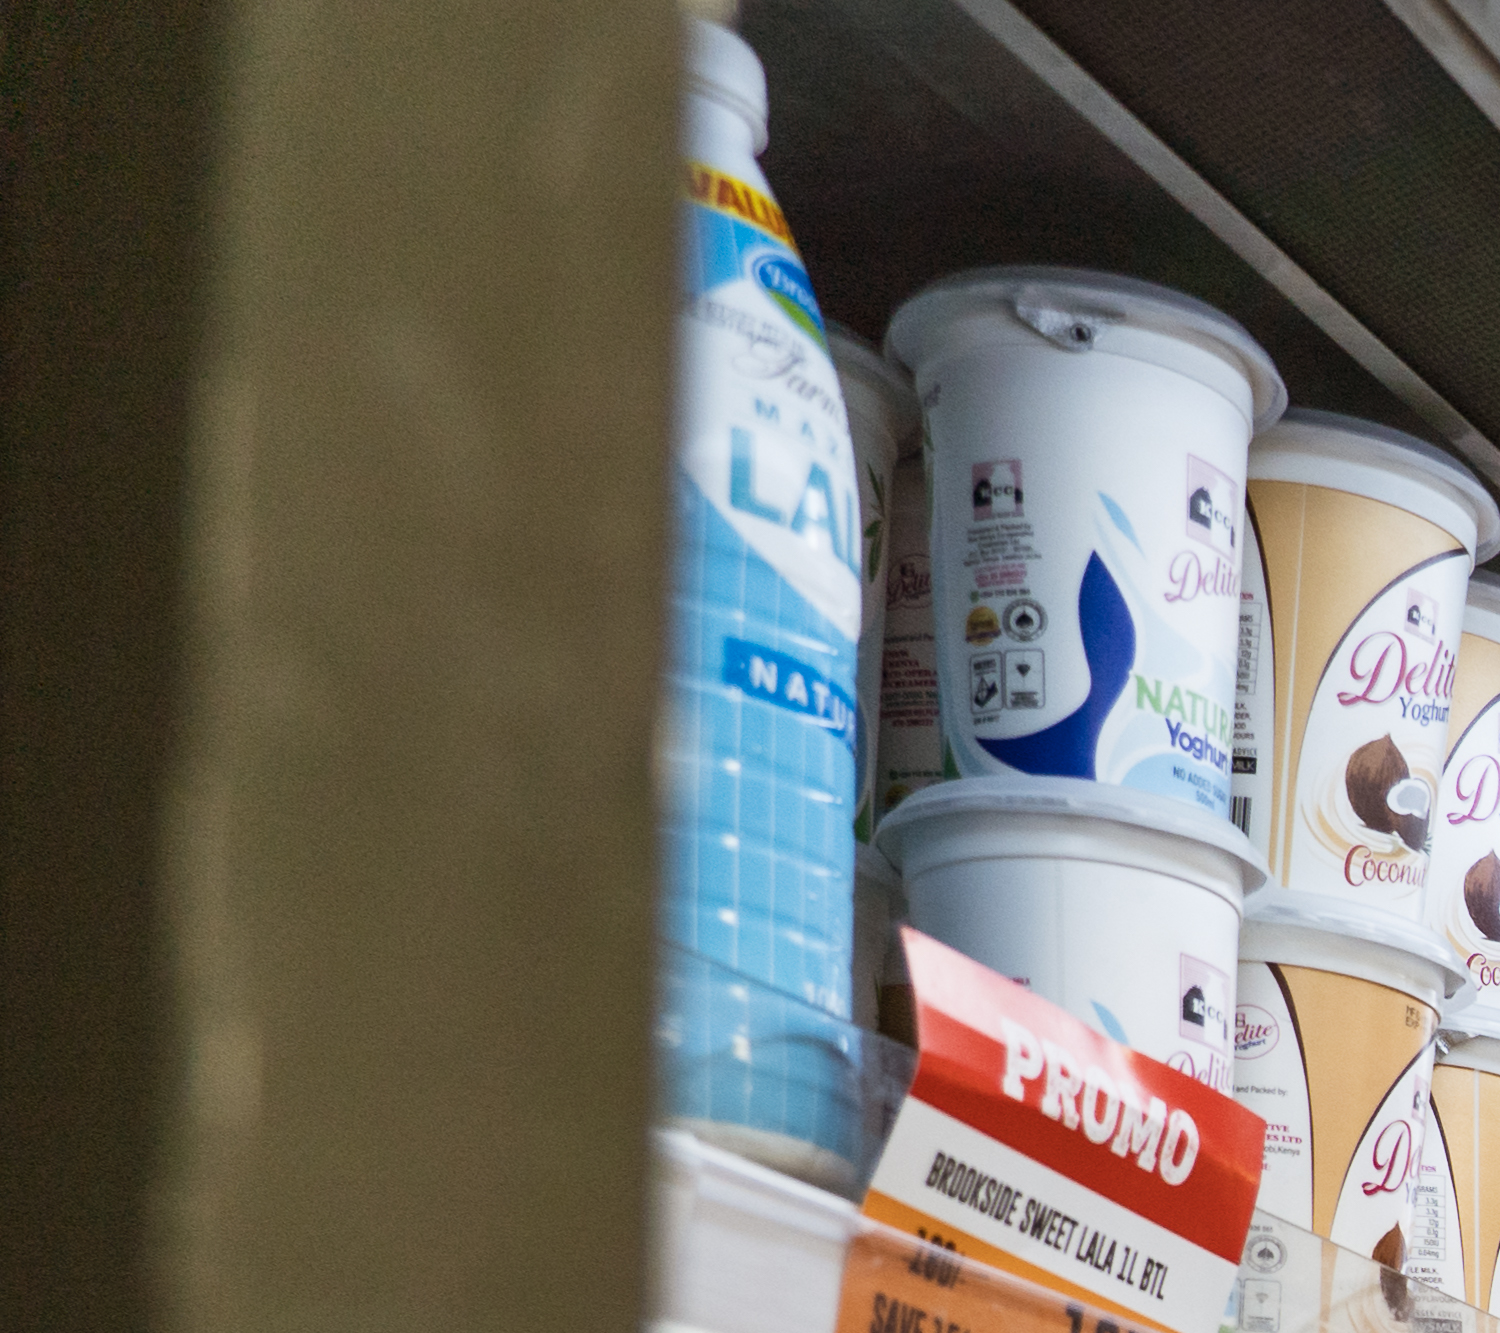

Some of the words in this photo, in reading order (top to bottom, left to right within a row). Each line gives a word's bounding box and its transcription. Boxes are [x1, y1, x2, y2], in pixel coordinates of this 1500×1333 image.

[997, 1015, 1201, 1187] PROMO
[925, 1150, 1019, 1229] BROOKSIDE
[1018, 1188, 1075, 1256] SWEET
[1075, 1214, 1116, 1270] LALA
[1138, 1251, 1169, 1302] BTL
